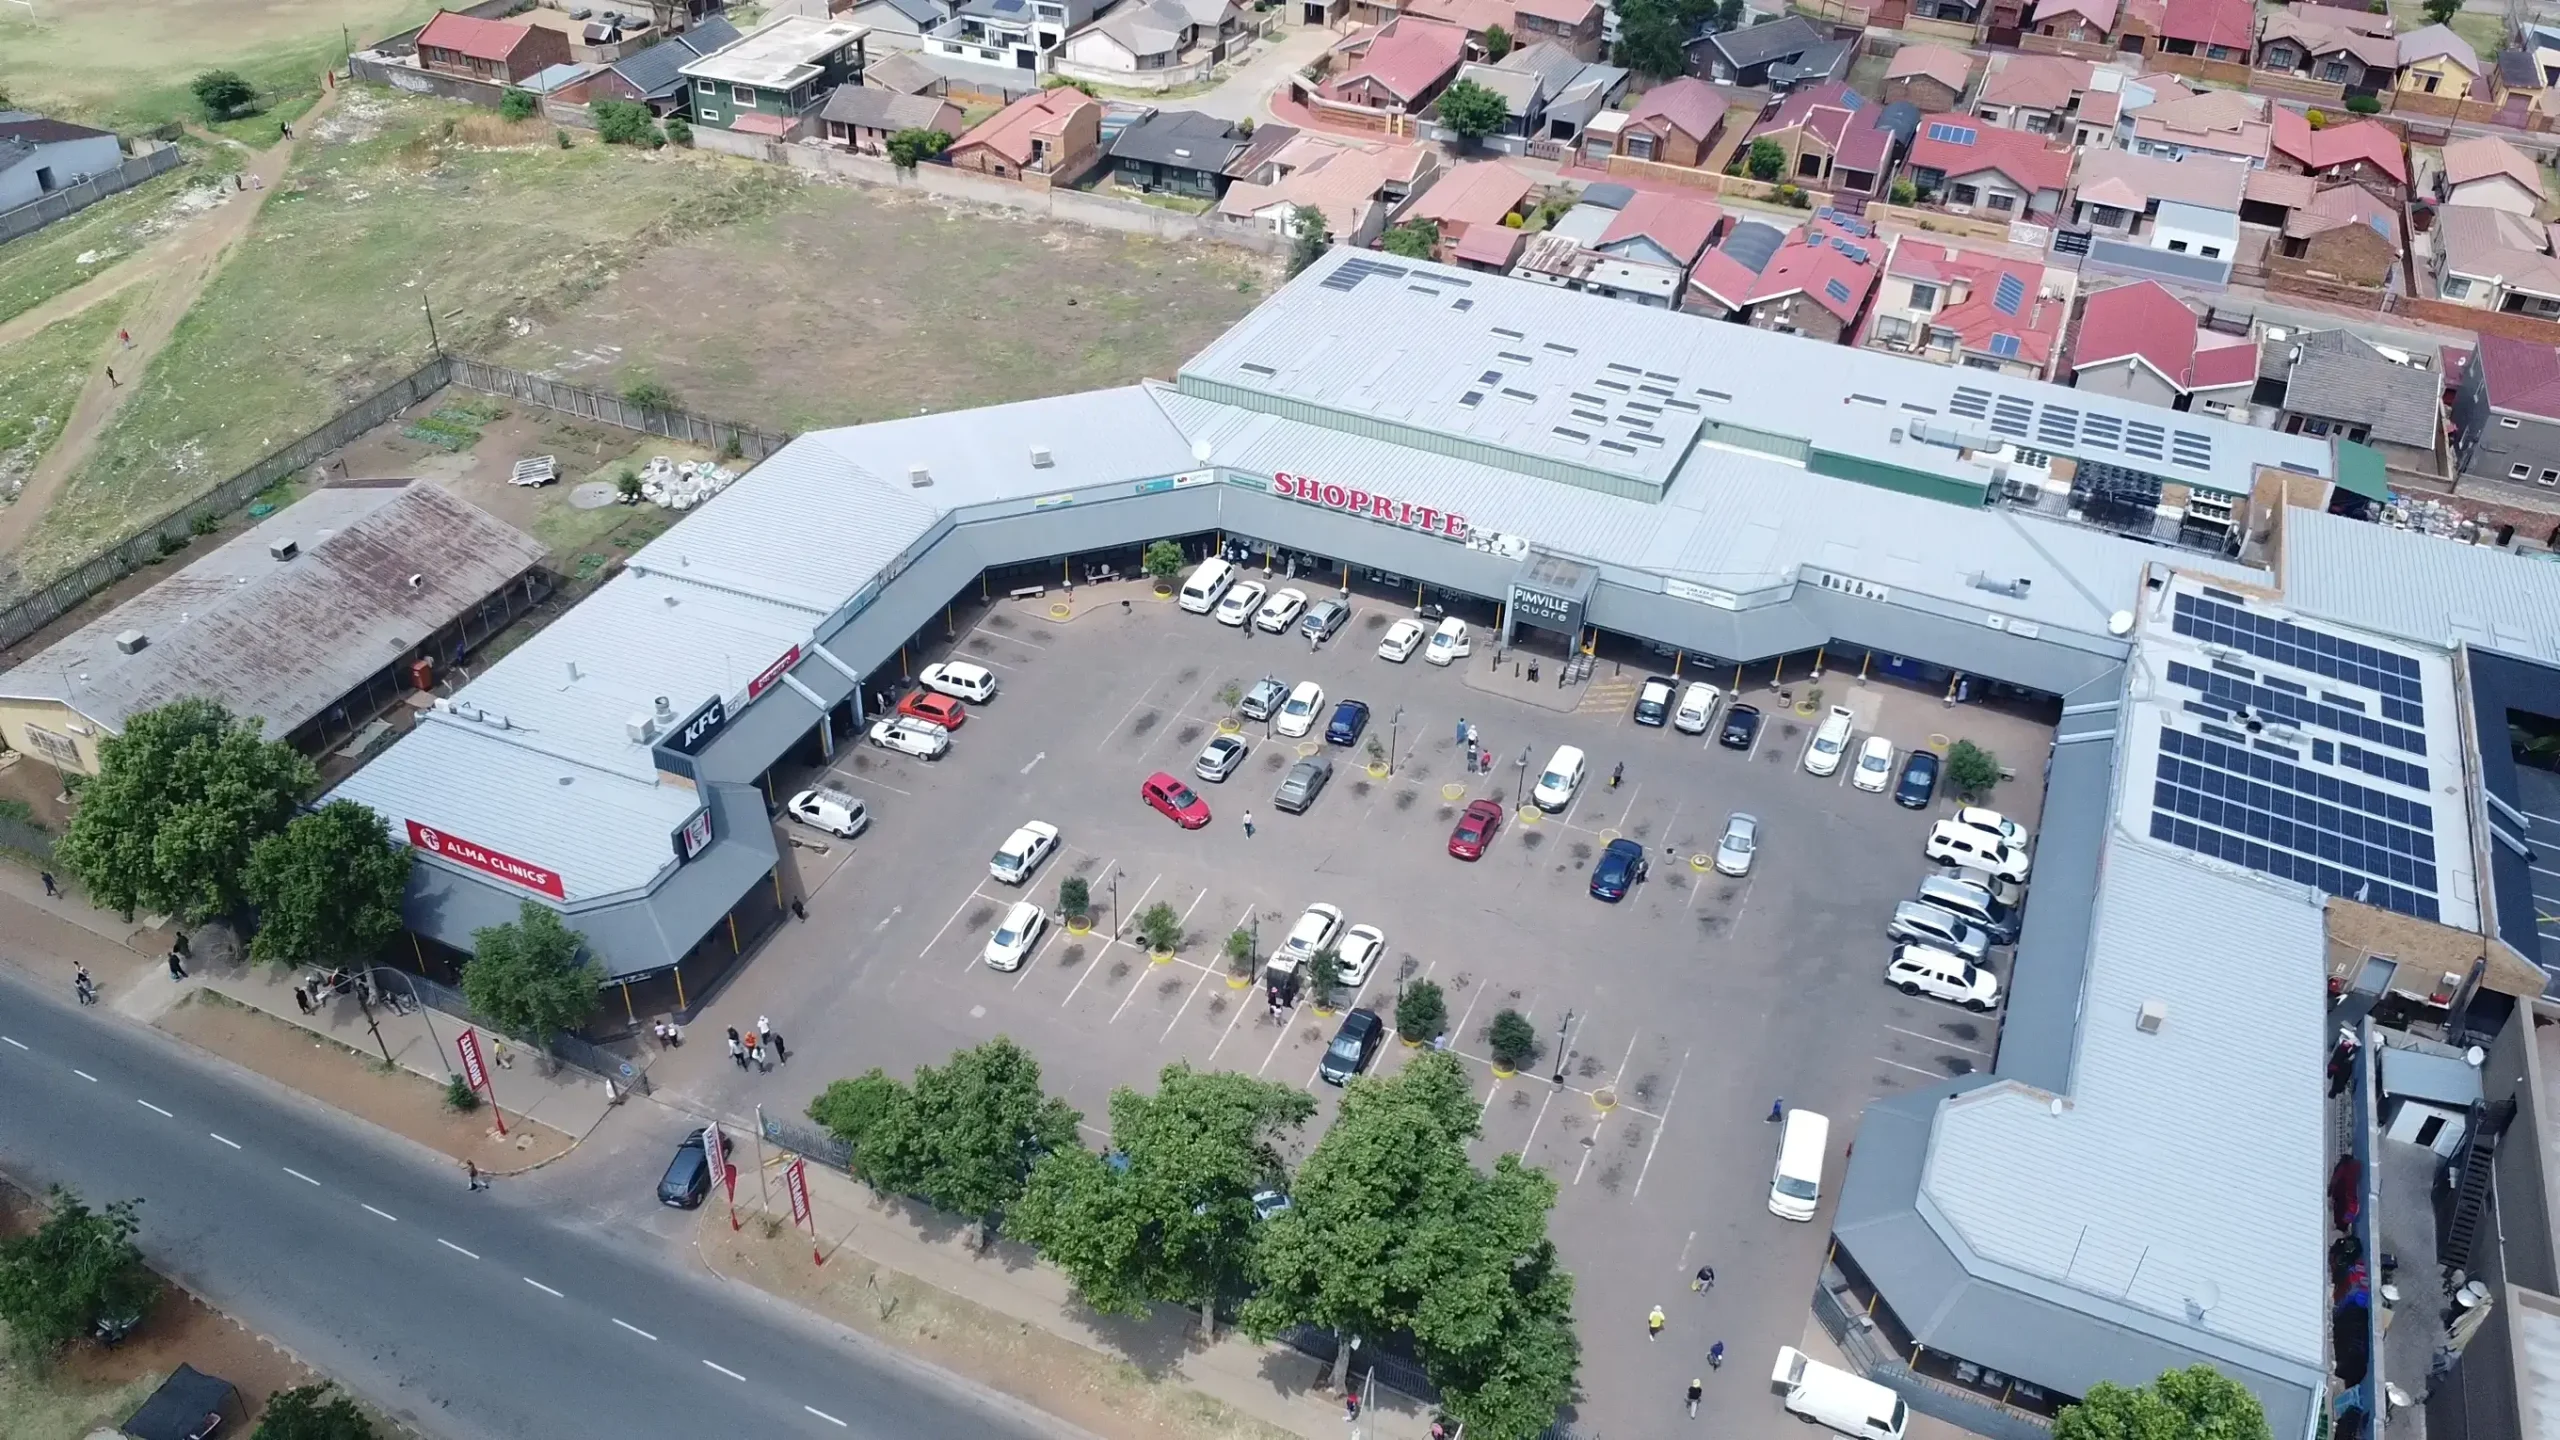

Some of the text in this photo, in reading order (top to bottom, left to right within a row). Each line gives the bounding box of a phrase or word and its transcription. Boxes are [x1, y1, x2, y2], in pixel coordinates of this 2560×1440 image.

[1273, 471, 1467, 538] SHOPRITE
[1514, 602, 1567, 622] square
[1515, 588, 1569, 613] PIMVILLE
[684, 703, 721, 748] KFC
[447, 841, 546, 885] ALMA CLINICS
[460, 1033, 482, 1086] SHOPRITE
[789, 1165, 806, 1219] SHOPRITE
